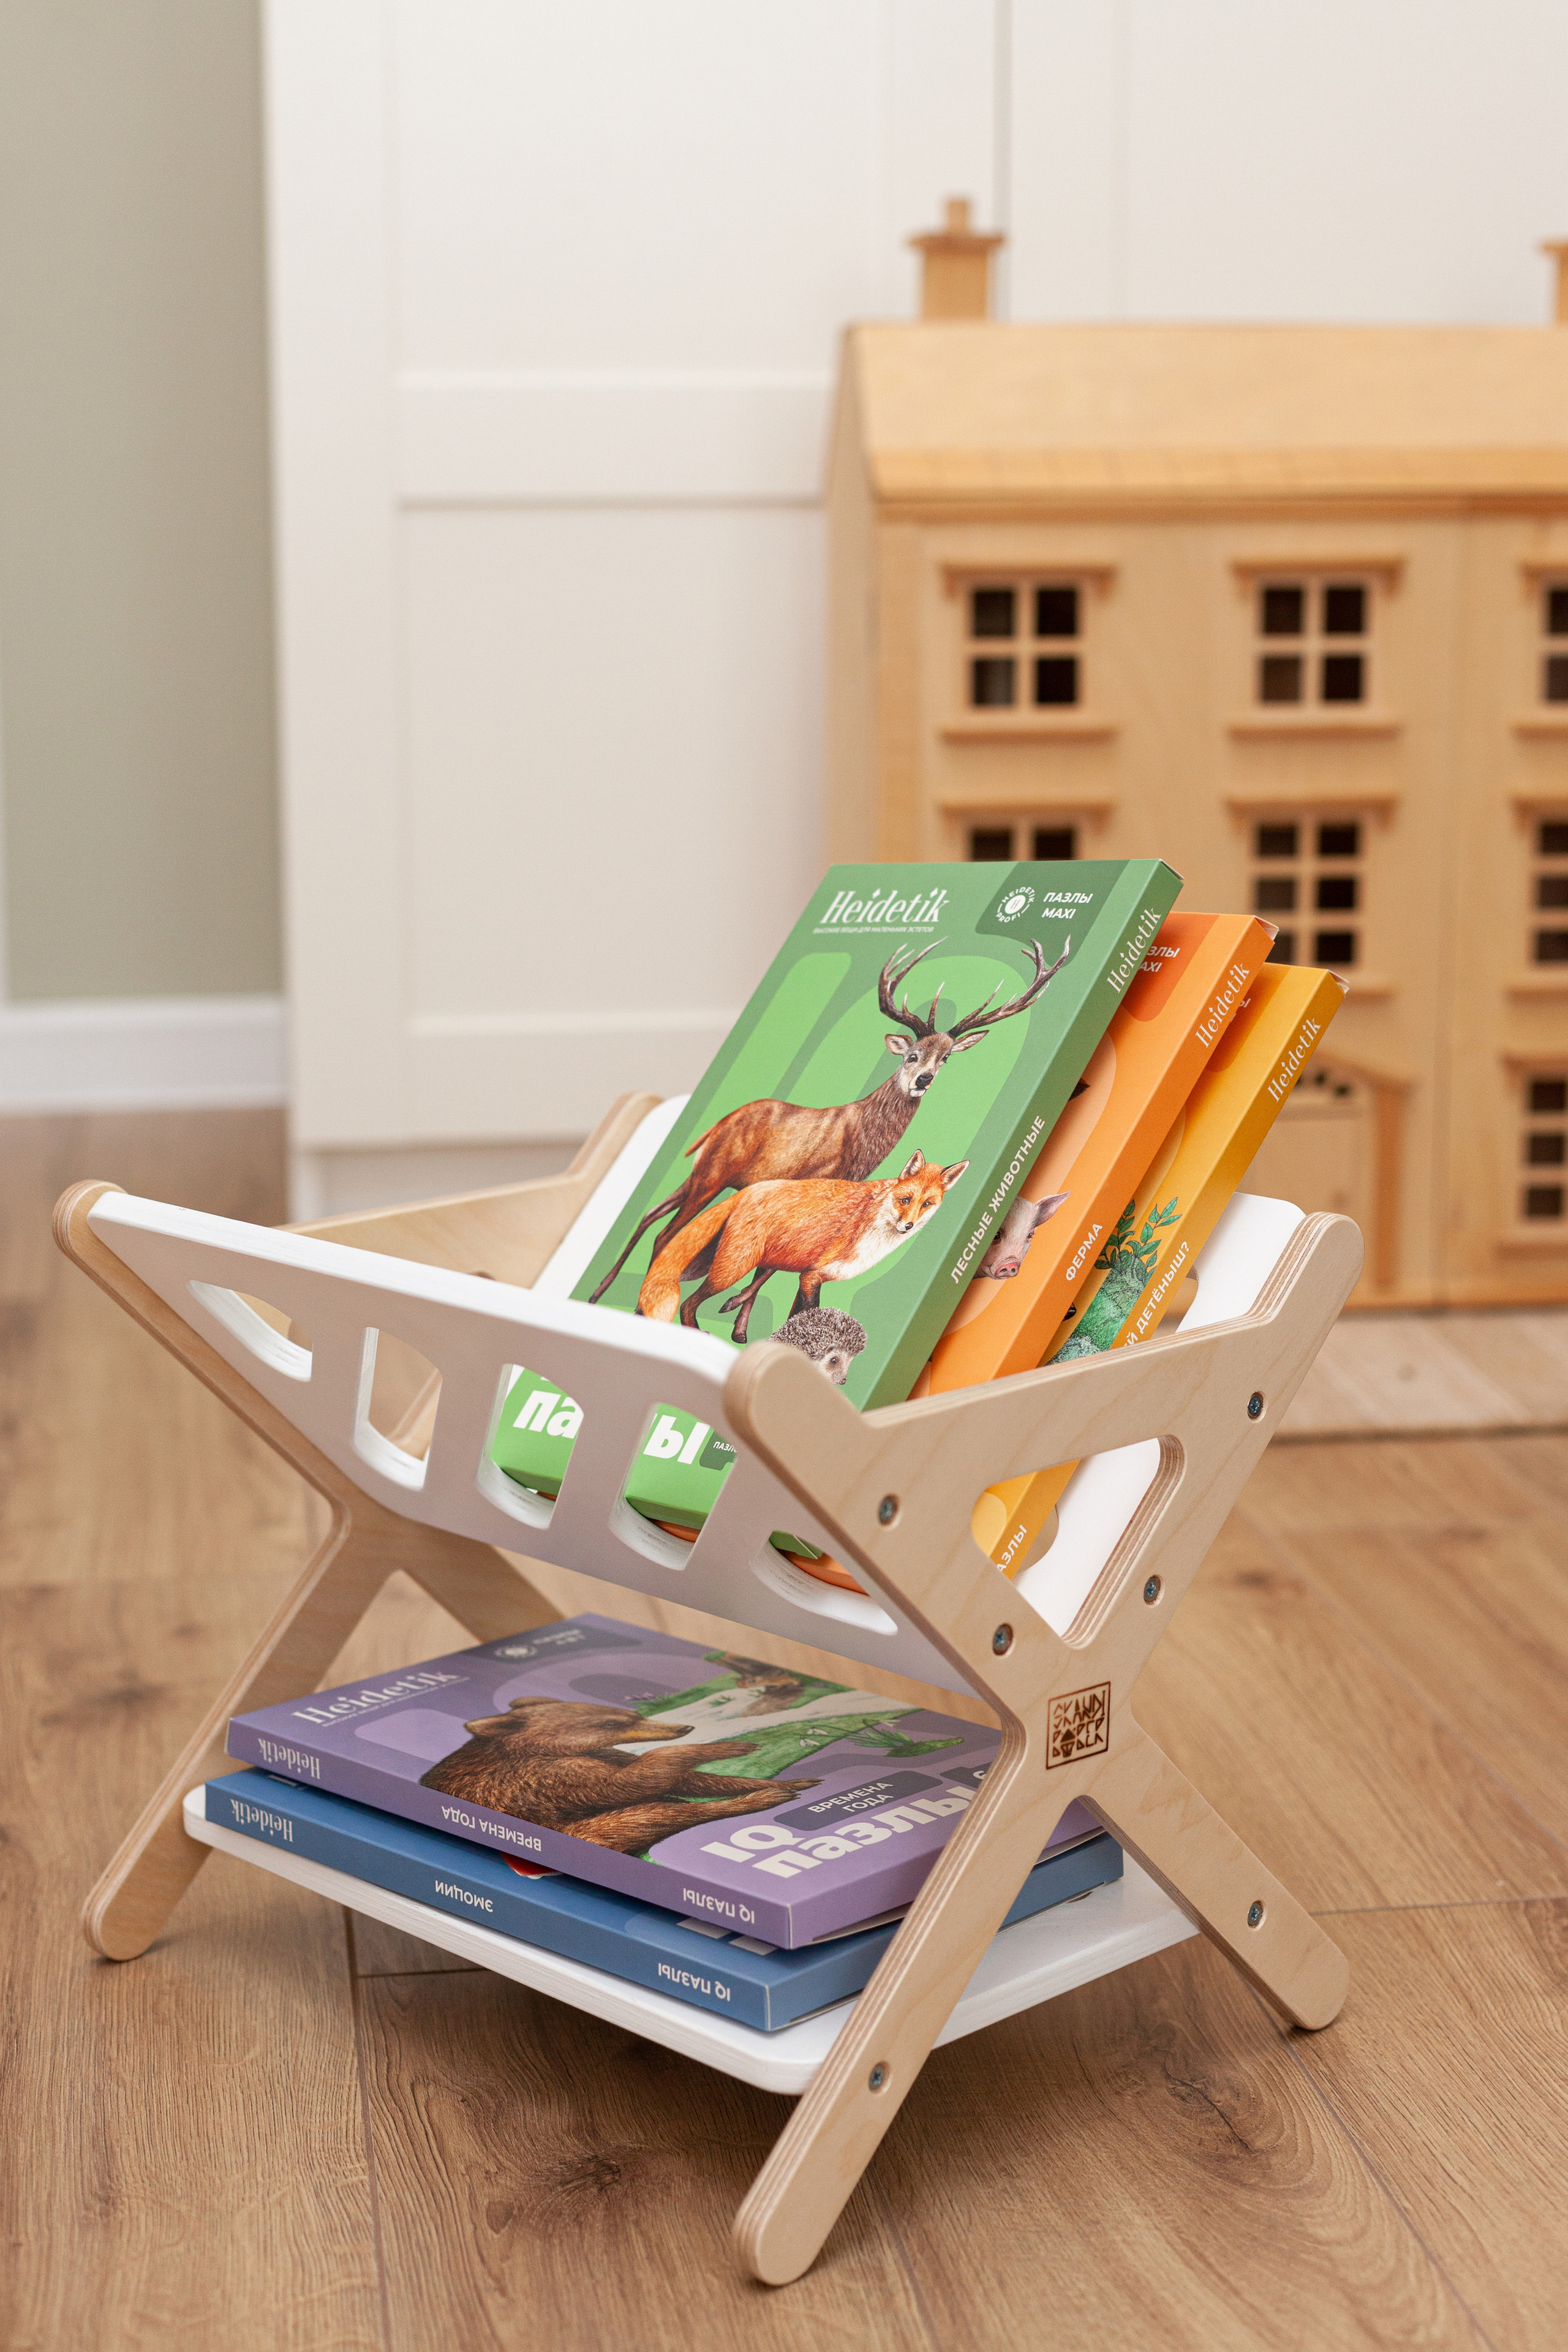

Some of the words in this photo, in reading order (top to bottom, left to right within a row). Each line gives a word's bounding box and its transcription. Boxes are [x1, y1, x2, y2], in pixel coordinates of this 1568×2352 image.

[820, 888, 949, 924] Heidetik
[1001, 886, 1035, 903] HEIDETIK
[1043, 892, 1093, 903] ПАЗЛЫ
[996, 912, 1021, 923] PROFI
[1042, 908, 1076, 919] MAXI
[1106, 908, 1161, 993] Heidetik
[1140, 961, 1163, 973] AXI
[1147, 946, 1180, 958] ЗЛЫ
[1195, 963, 1250, 1048] Heidetik
[1267, 1018, 1321, 1102] Heidetik
[951, 1212, 993, 1284] ЛЕСНЫЕ
[988, 1116, 1045, 1213] ЖИВОТНЫЕ
[1066, 1224, 1102, 1281] ФЕРМА
[1136, 1241, 1189, 1334] ДЕТЁНЫШ?
[997, 1525, 1027, 1572] АЗЛЫ
[293, 1672, 458, 1724] Heidetik
[258, 1738, 320, 1779] Heidetik
[807, 1781, 894, 1814] ВРЕМЕНА
[842, 1793, 894, 1813] ГОДА
[230, 1799, 293, 1842] Heidetik
[441, 1806, 475, 1829] ГОДА
[752, 1785, 976, 1879] пазлы
[479, 1819, 541, 1852] ВРЕМЕНА
[699, 1825, 806, 1863] IQ
[435, 1880, 494, 1912] ЭМОЦИИ
[683, 1888, 735, 1918] ПАЗЛЫ
[739, 1904, 755, 1924] IQ
[658, 1962, 711, 1994] ПАЗЛЫ
[715, 1980, 731, 2002] IQ
